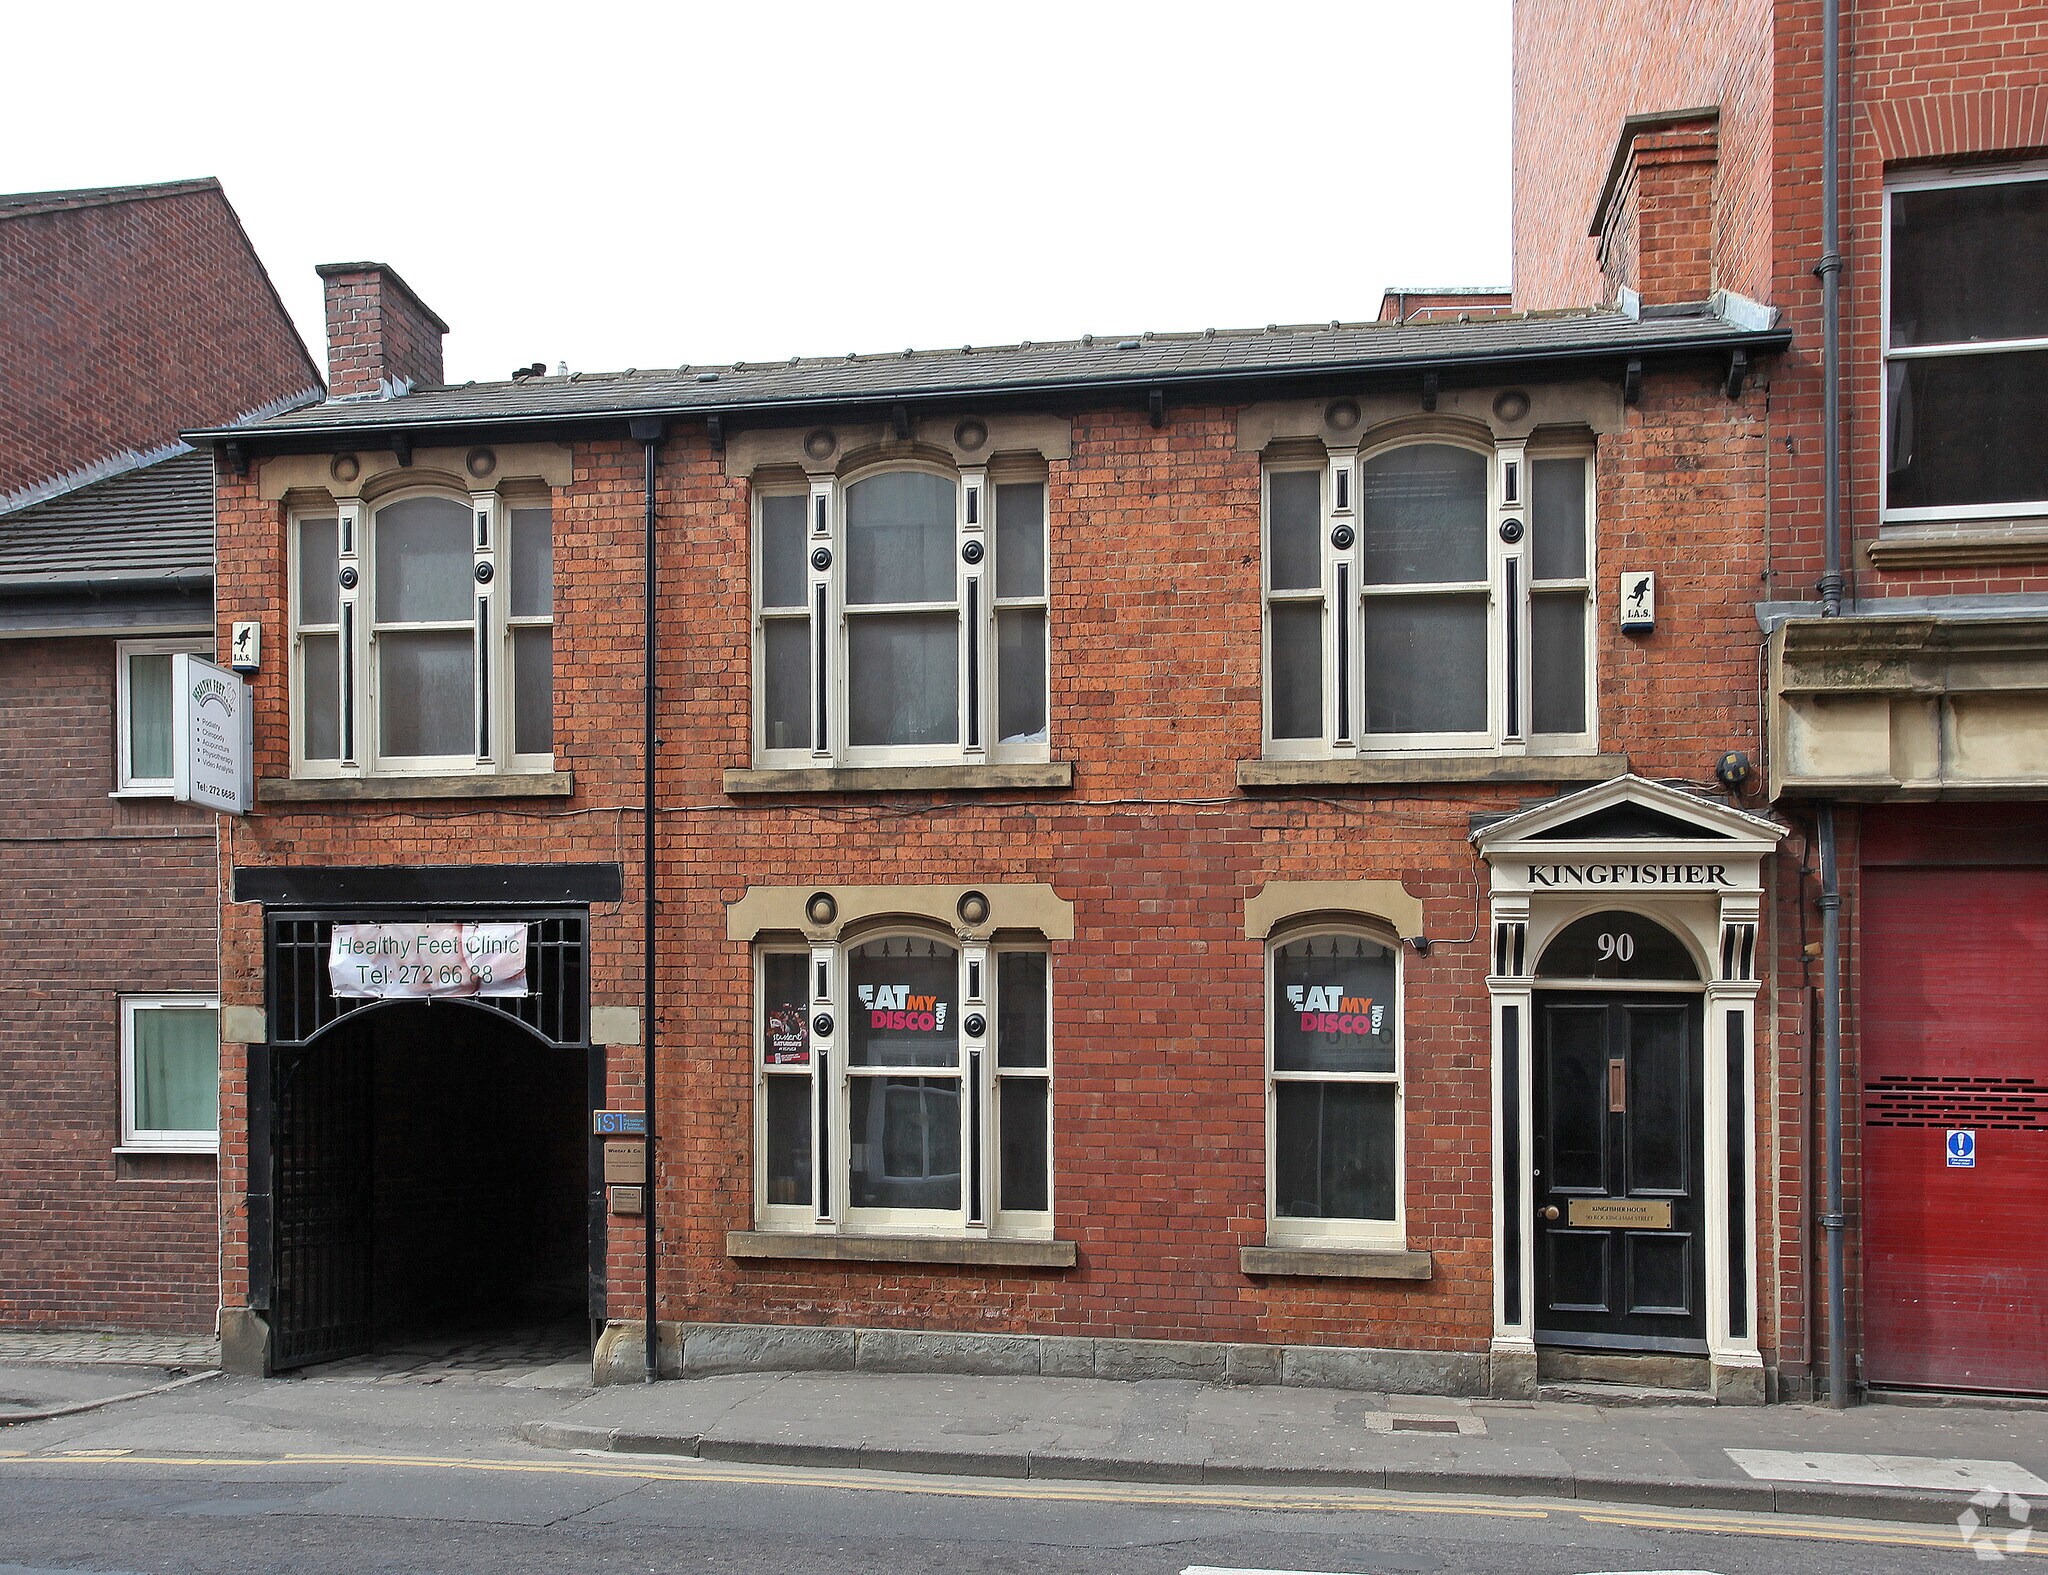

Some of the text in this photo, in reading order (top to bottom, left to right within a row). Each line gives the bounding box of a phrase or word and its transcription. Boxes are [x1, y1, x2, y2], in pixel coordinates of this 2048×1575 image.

[1627, 609, 1651, 618] I.A.S.
[233, 654, 252, 662] I.A.S.
[192, 678, 226, 702] HEALTHY FEET
[202, 728, 225, 743] Chiropody
[202, 738, 230, 753] Acupuncture
[202, 748, 234, 766] Physiotherapy
[202, 758, 235, 774] Video Analysis
[196, 781, 236, 801] Tel: 272 6688
[1527, 864, 1738, 886] KINGFISHER
[338, 935, 520, 959] Healthy Feet Clinic
[1597, 933, 1635, 962] 90
[356, 965, 493, 984] Tel: 272 66 88
[858, 984, 937, 1011] EAT MY
[1287, 985, 1373, 1014] EAT MY
[871, 1010, 936, 1031] DISCO
[1301, 1012, 1371, 1035] DISCO
